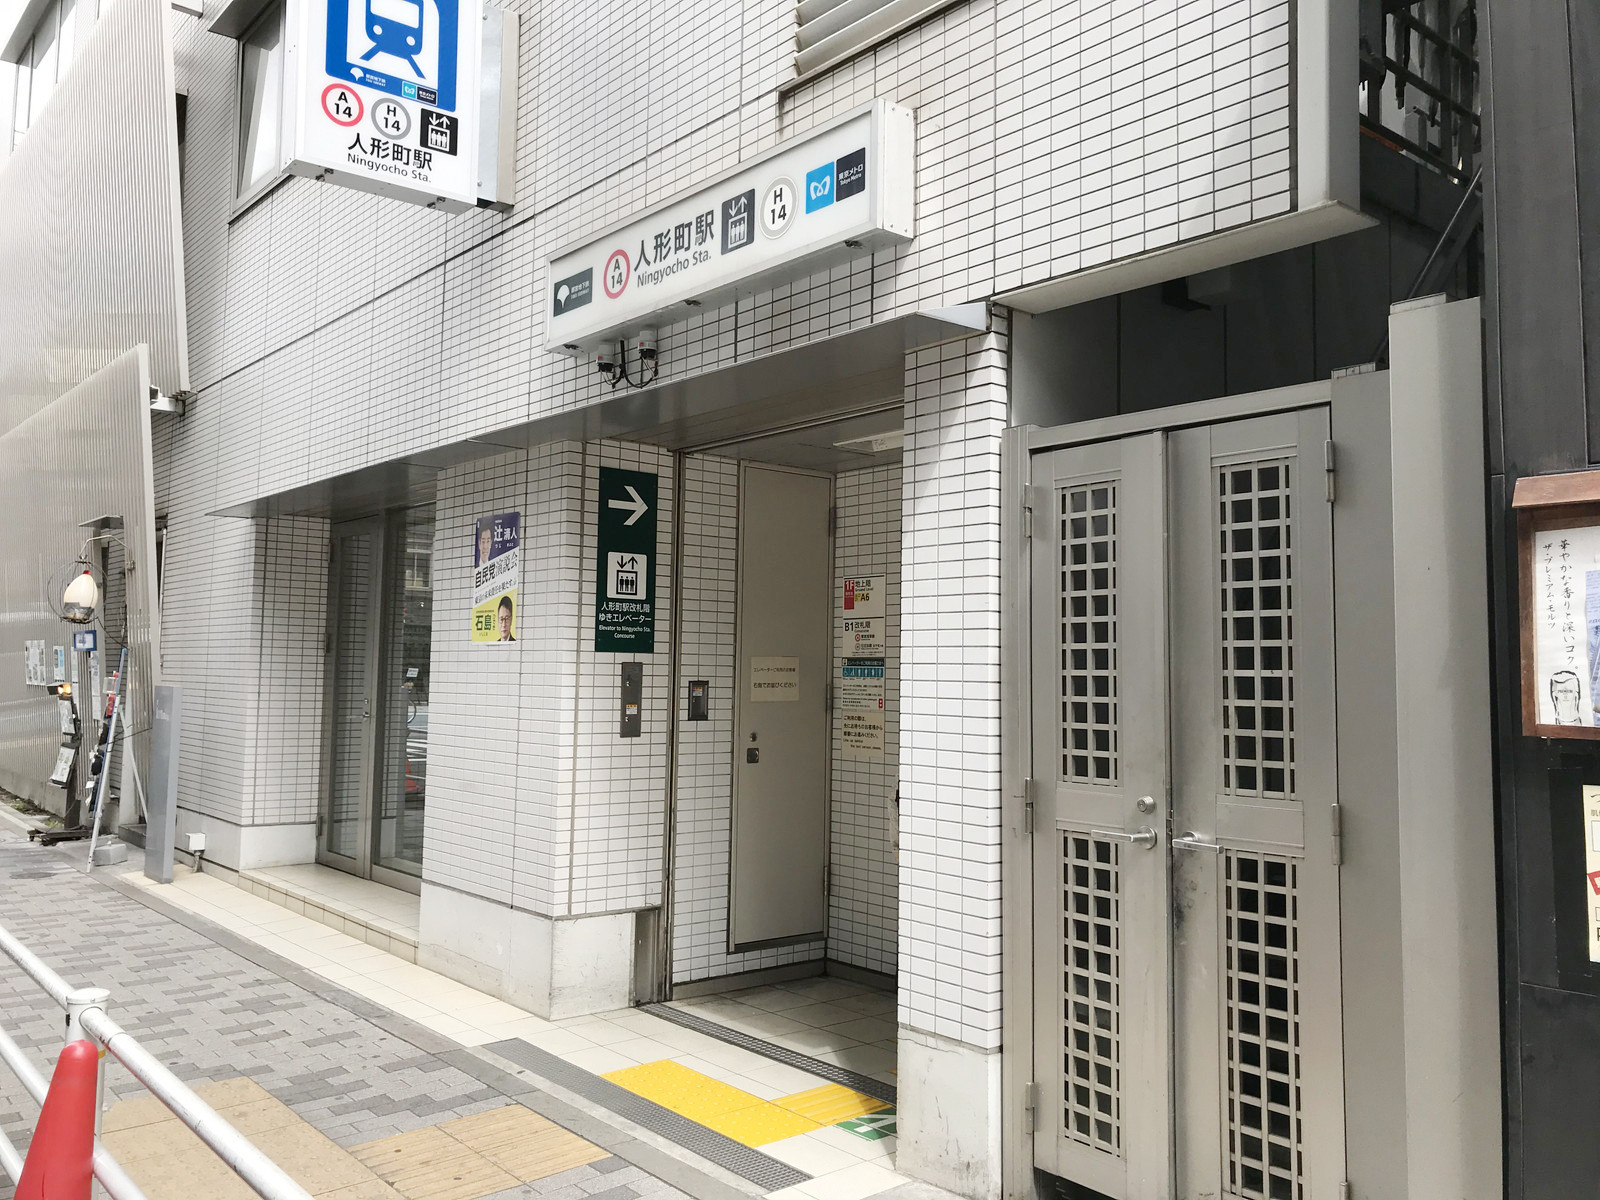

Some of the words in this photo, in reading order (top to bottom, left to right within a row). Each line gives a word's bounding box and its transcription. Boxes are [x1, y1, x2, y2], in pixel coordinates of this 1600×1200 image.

[338, 91, 348, 104] A
[334, 103, 352, 118] 14
[386, 105, 397, 117] H
[383, 117, 400, 132] 14
[348, 132, 432, 171] 人形町駅
[347, 152, 408, 177] Ningyocho
[412, 170, 432, 183] Sta.
[838, 164, 864, 180] 東京メトロ
[774, 187, 783, 205] H
[770, 204, 786, 225] 14
[634, 209, 714, 272] 人形町駅
[613, 258, 620, 272] A
[637, 258, 689, 288] Ningyocho
[692, 250, 712, 266] Sta.
[611, 271, 623, 289] 14
[861, 593, 870, 601] A6
[1558, 538, 1580, 670] 華やかな香りと深いコク。
[601, 602, 650, 613] 人形町駅改札階
[598, 613, 652, 623] ゆきエレベーター
[844, 622, 854, 631] B1
